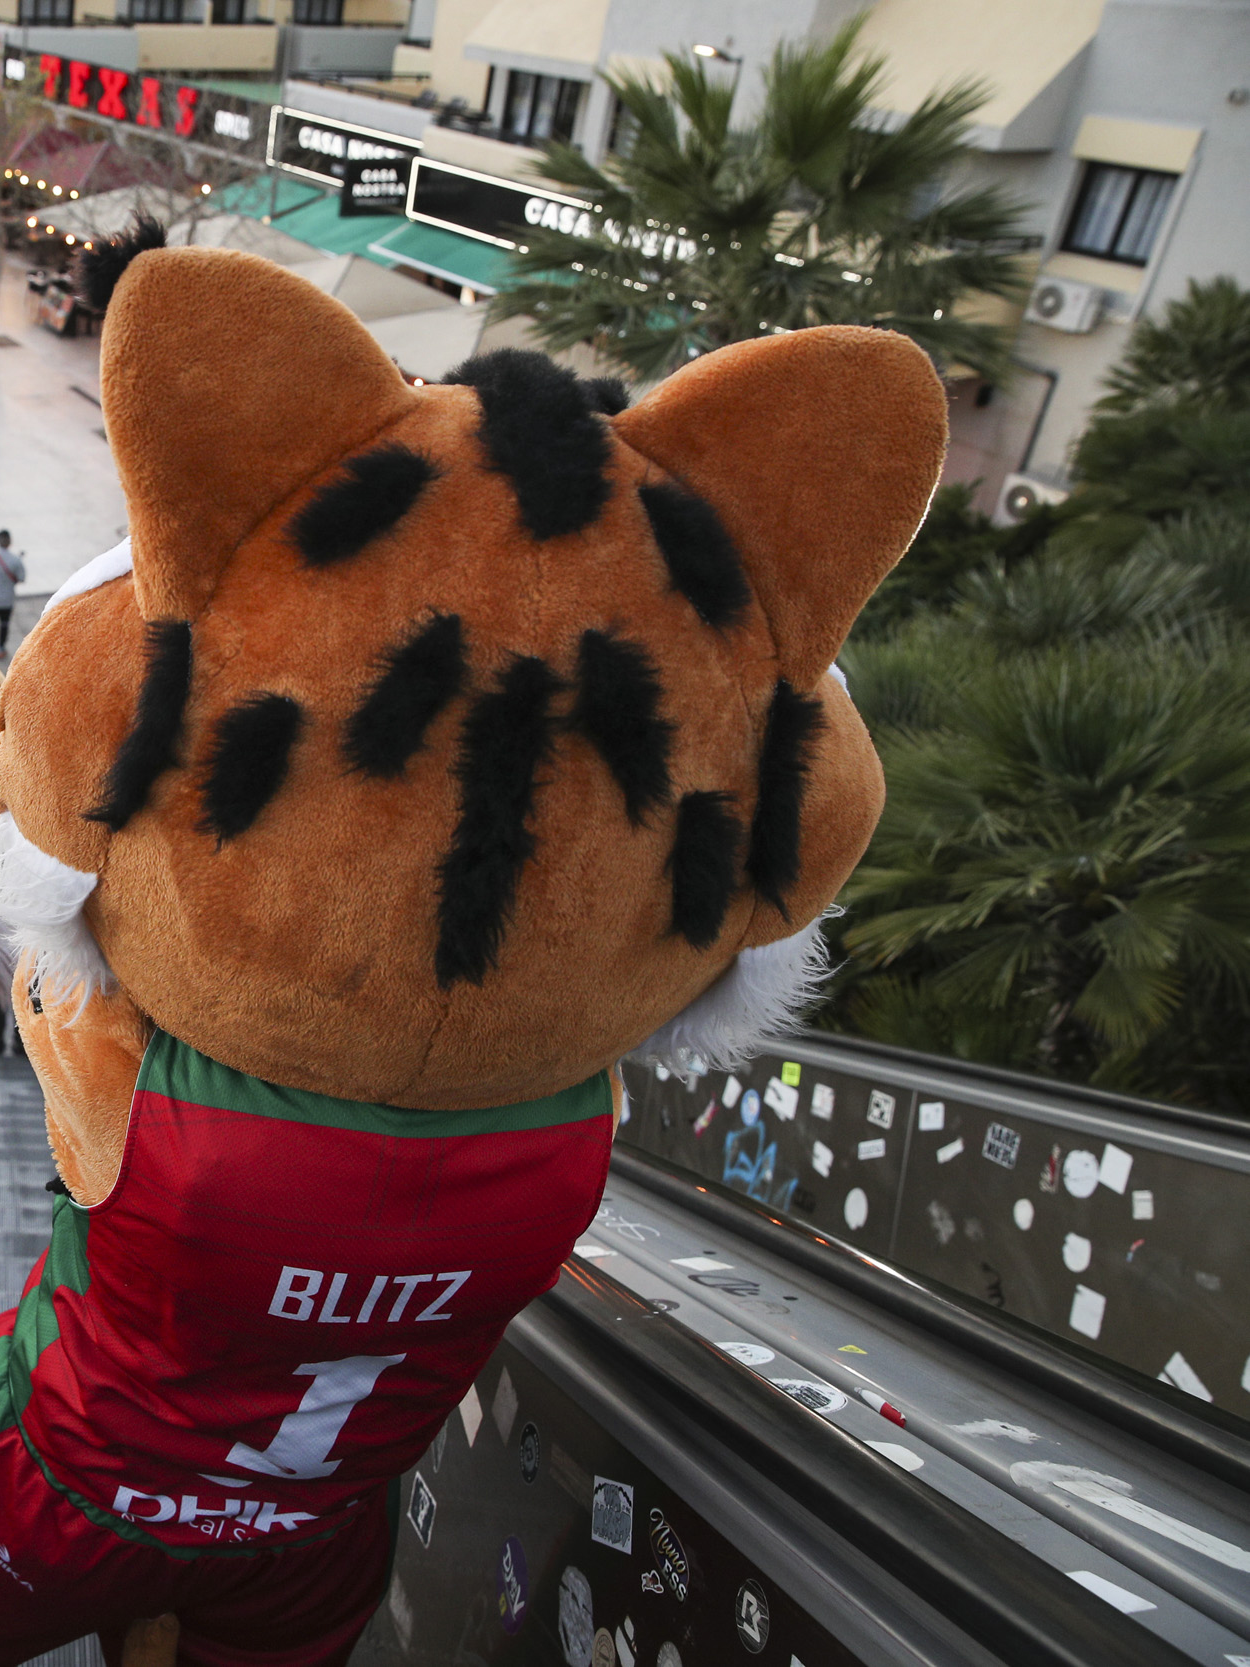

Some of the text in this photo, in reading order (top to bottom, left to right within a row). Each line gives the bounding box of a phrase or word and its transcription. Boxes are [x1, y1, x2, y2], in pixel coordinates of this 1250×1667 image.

[40, 53, 197, 137] TEXAS
[298, 126, 343, 159] CASA
[524, 197, 592, 240] CASA
[267, 1265, 472, 1324] BLITZ
[225, 1352, 407, 1480] 1
